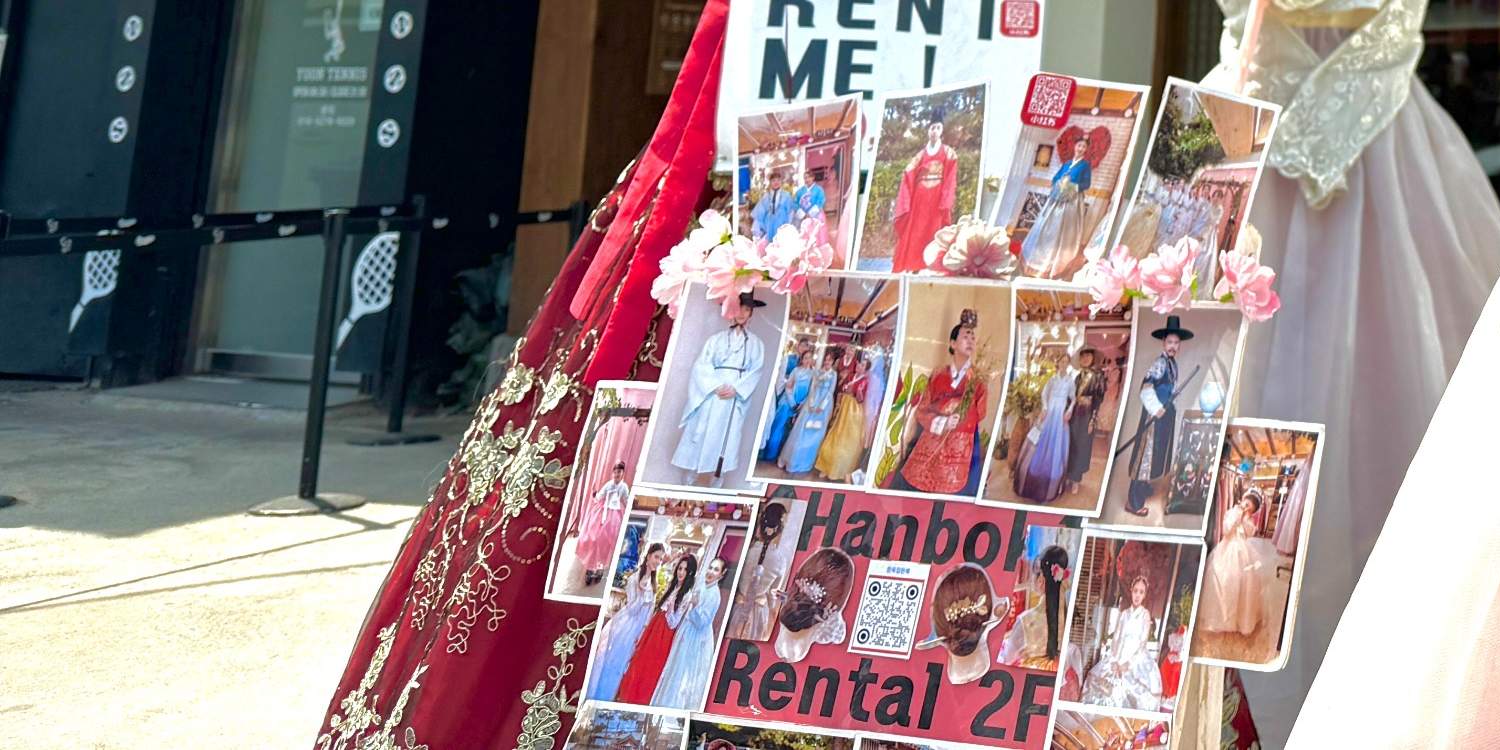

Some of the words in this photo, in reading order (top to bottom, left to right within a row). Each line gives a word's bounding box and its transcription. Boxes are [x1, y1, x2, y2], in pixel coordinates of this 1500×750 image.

[758, 38, 877, 99] ME
[713, 639, 943, 730] Rental
[970, 669, 1056, 742] 2F
